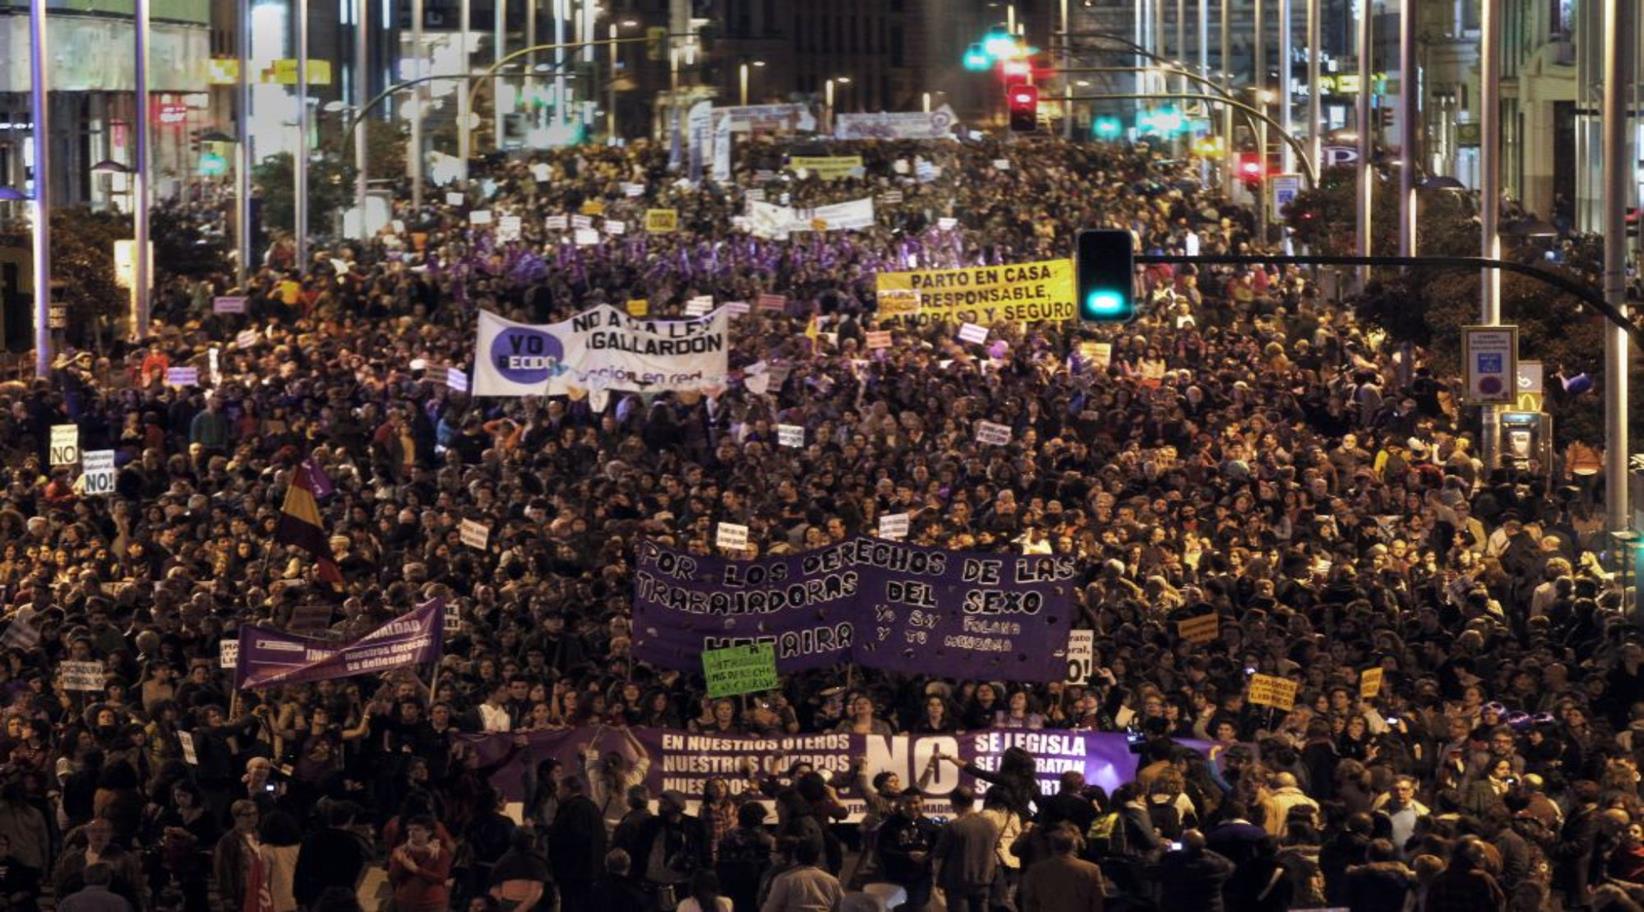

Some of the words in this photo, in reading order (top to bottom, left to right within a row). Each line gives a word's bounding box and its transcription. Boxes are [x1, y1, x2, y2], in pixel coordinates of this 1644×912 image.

[911, 272, 969, 287] PARTO
[975, 270, 998, 284] EN
[1004, 302, 1073, 320] SEGURO
[573, 311, 600, 332] NO
[608, 310, 620, 327] A
[52, 446, 76, 463] NO
[85, 472, 114, 492] NO!
[640, 540, 697, 580] POR
[722, 563, 788, 587] LOS
[802, 537, 946, 575] DERECHOS
[962, 559, 1002, 585] DE
[1015, 557, 1074, 583] LAS
[636, 570, 858, 616] TRABAJADORAS
[887, 581, 938, 608] DEL
[963, 589, 1042, 615] SEXO
[1068, 660, 1089, 683] O!
[662, 734, 684, 750] EN
[688, 735, 778, 751] NUESTROS
[975, 733, 999, 752] SE
[1004, 733, 1086, 756] LEGISLA
[763, 755, 850, 773] CUPOS
[866, 735, 959, 794] NO
[975, 757, 994, 772] SE
[663, 778, 750, 796] NUESOS
